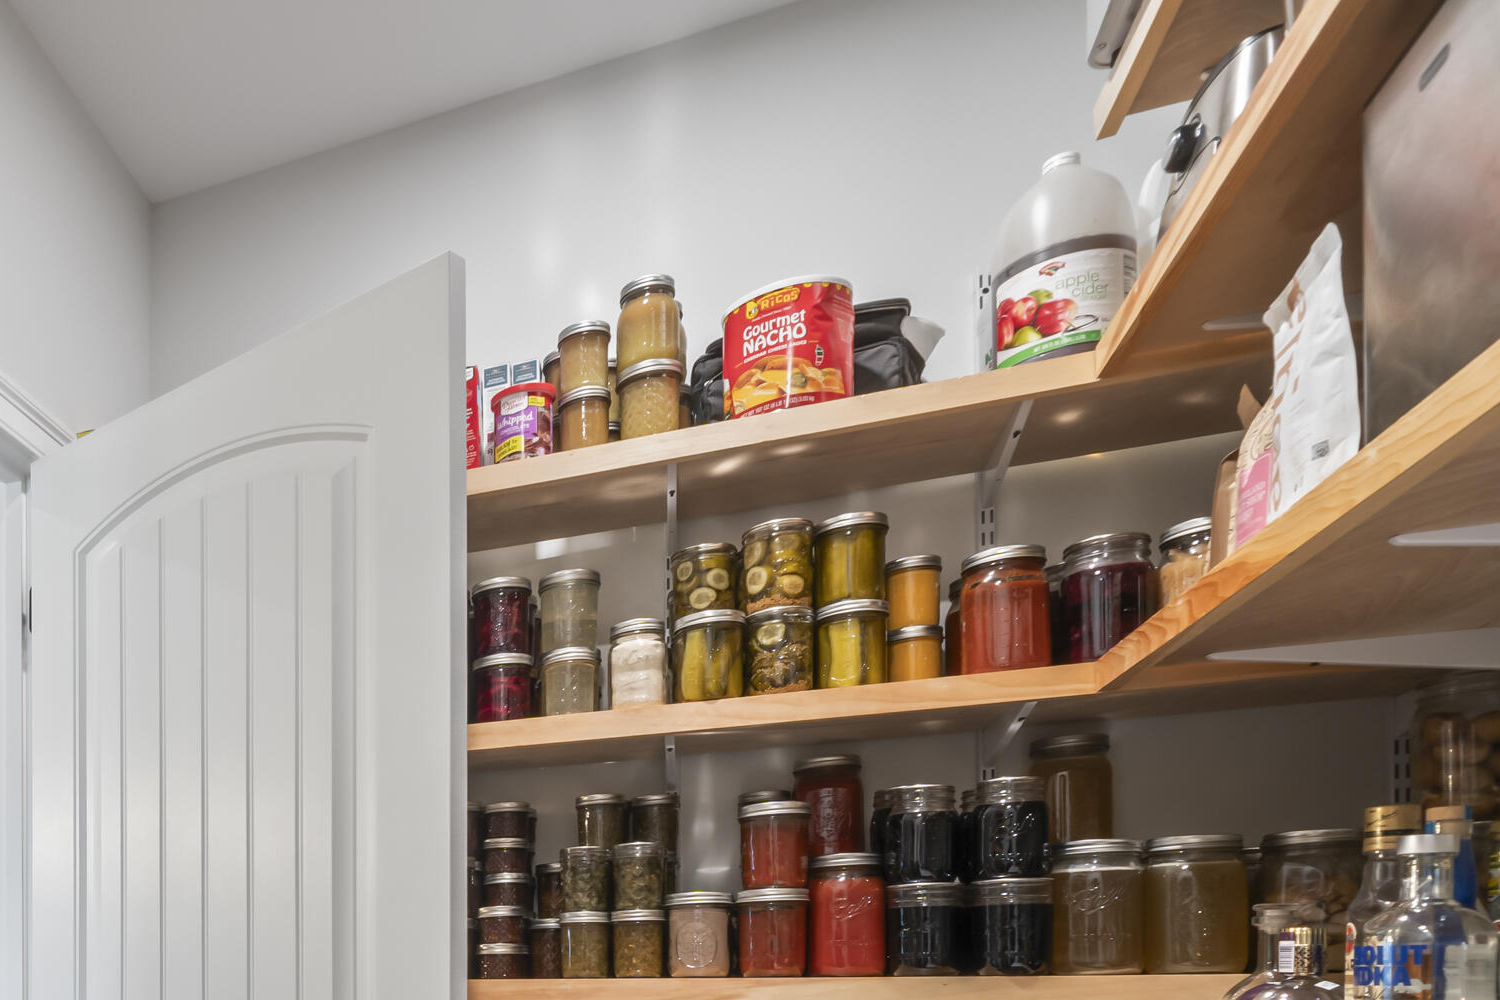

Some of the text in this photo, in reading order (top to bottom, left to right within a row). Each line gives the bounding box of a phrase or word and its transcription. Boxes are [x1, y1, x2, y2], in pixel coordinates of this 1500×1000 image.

[1055, 271, 1100, 290] apple
[1071, 282, 1109, 298] cider
[743, 309, 806, 340] Gourmet
[743, 323, 807, 357] NACHO
[1355, 944, 1428, 967] OLUT
